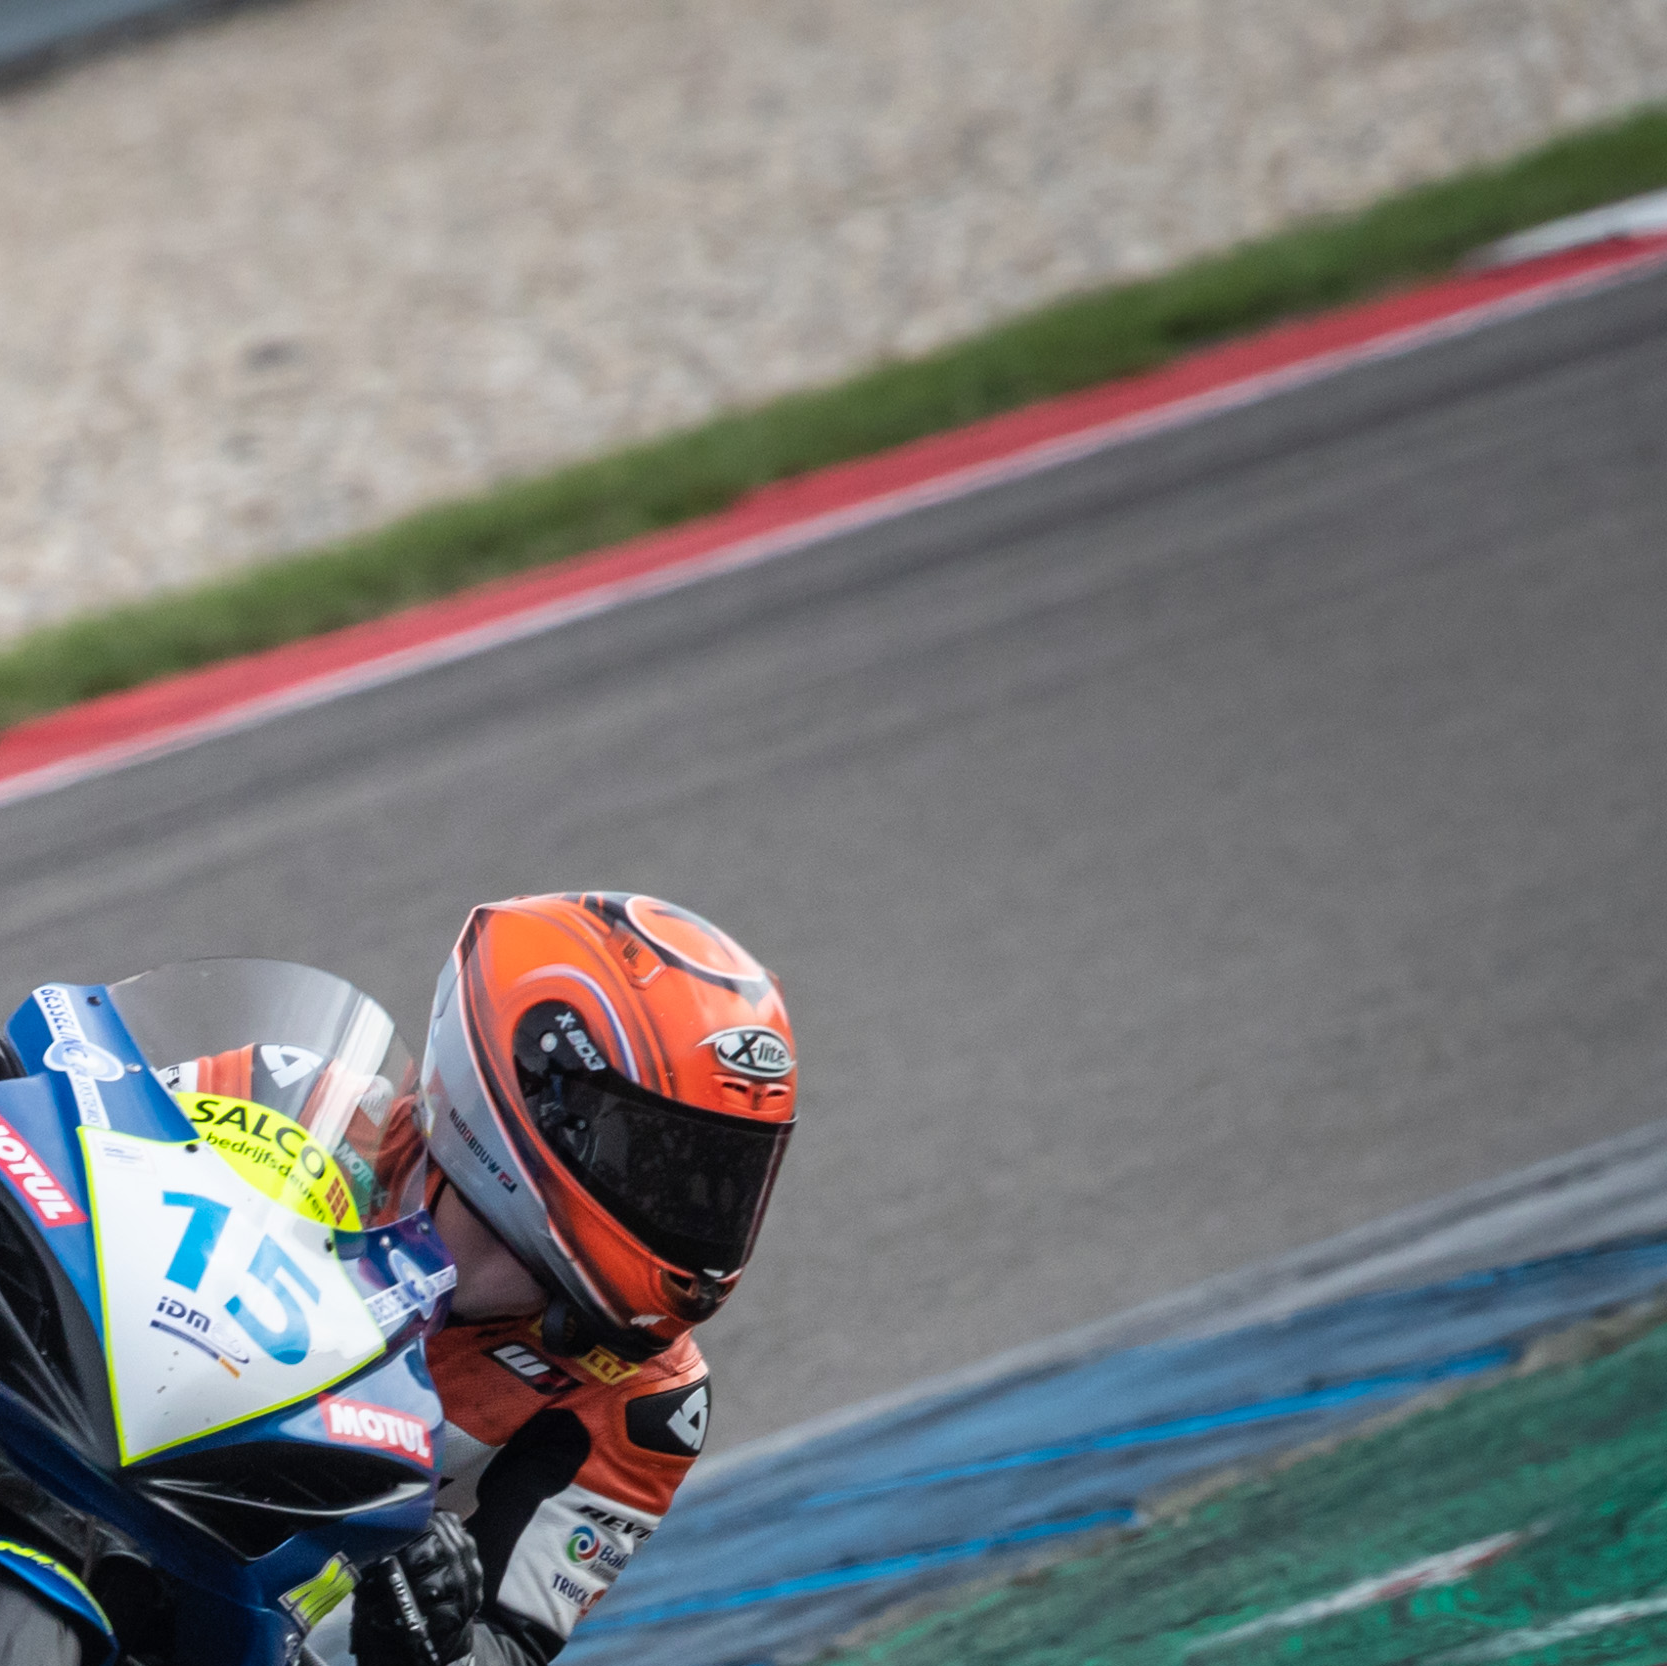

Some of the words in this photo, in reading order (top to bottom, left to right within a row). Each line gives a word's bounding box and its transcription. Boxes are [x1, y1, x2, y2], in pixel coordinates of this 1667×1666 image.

[190, 1099, 327, 1180] SALCO
[161, 1189, 322, 1366] 15
[329, 1403, 431, 1458] MOTUL
